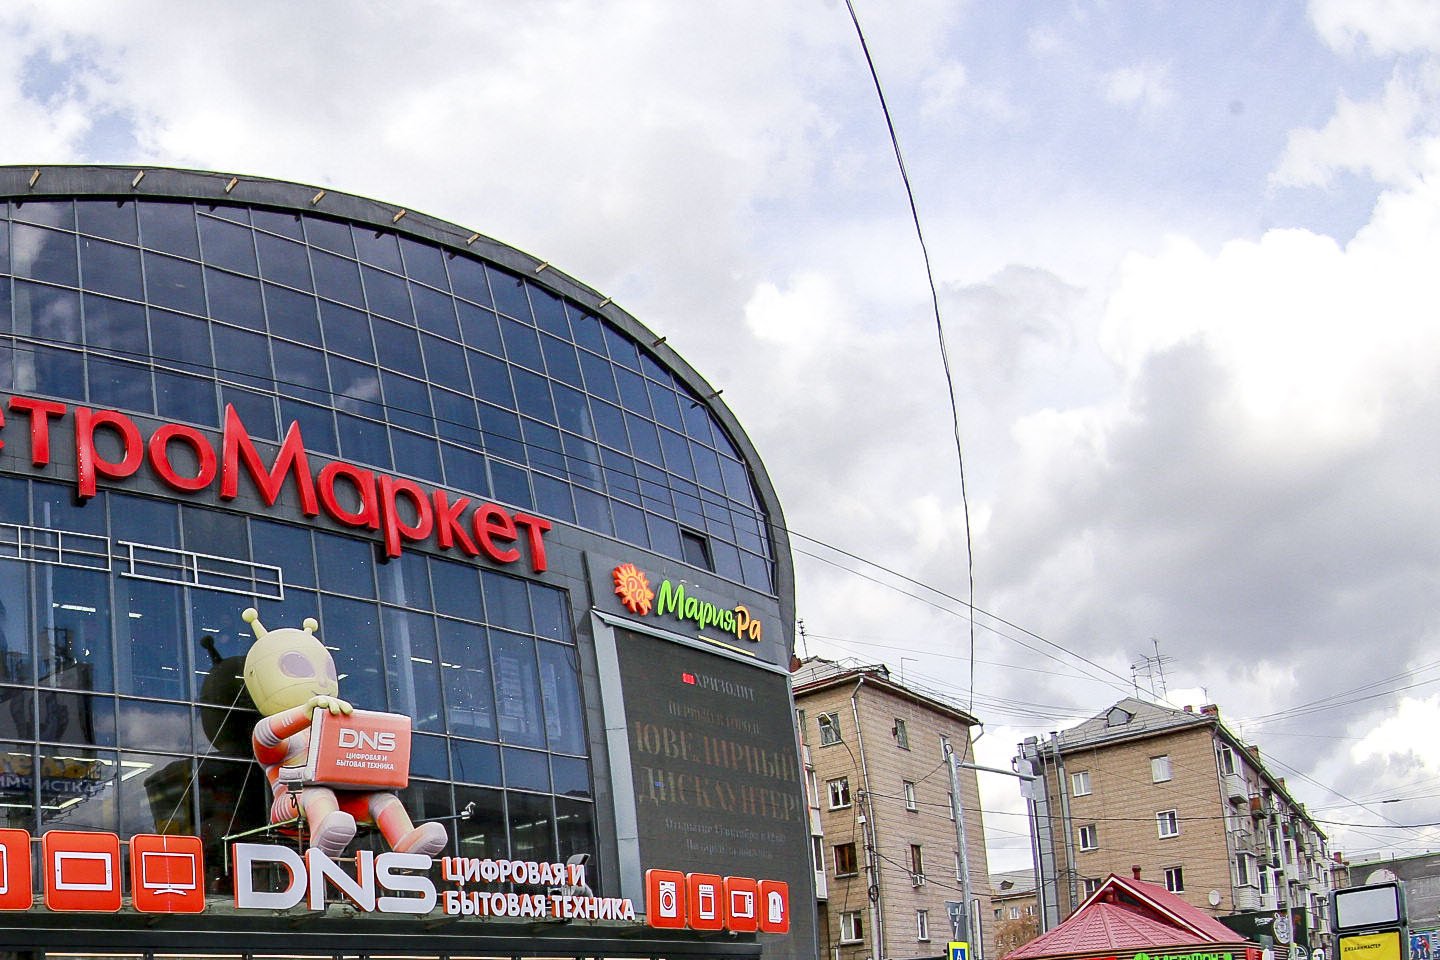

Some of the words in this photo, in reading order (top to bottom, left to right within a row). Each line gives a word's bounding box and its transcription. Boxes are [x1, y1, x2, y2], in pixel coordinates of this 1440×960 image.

[338, 728, 396, 752] DNS
[336, 759, 365, 768] БЫТОВАЯ
[367, 762, 395, 771] ТЕХНИКА
[345, 752, 381, 761] ЦИФРОВАЯ
[233, 843, 437, 914] DNS
[442, 856, 566, 887] ЦИФРОВАЯ
[566, 863, 586, 887] И
[442, 890, 546, 917] БЫТОВАЯ
[550, 894, 636, 921] ТЕХНИКА
